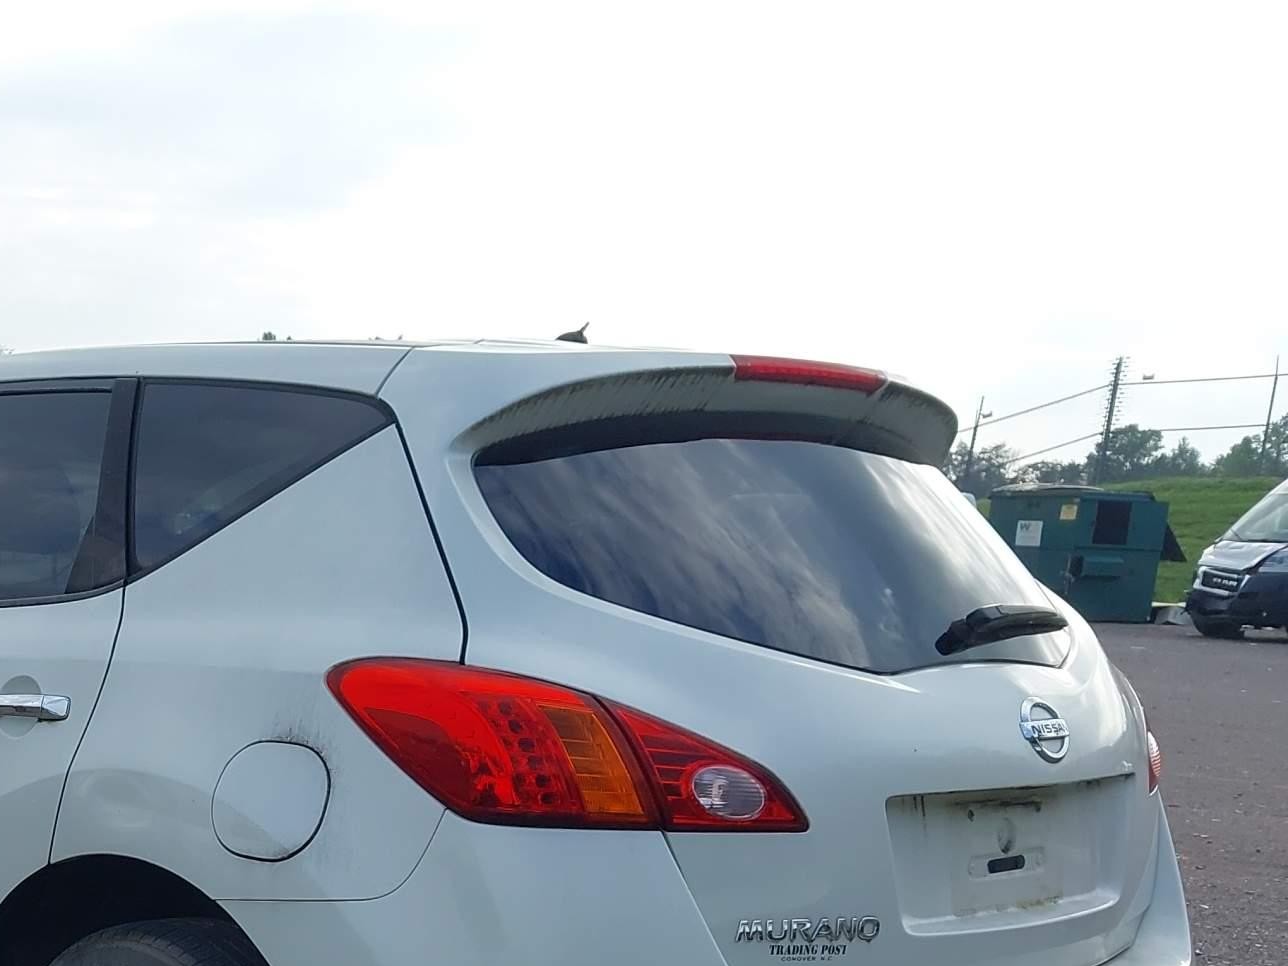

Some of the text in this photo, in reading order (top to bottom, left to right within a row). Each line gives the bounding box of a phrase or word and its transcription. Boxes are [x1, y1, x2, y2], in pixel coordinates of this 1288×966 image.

[1031, 723, 1066, 737] NISSA
[735, 916, 881, 943] MURANO
[769, 944, 847, 956] TRADING POST
